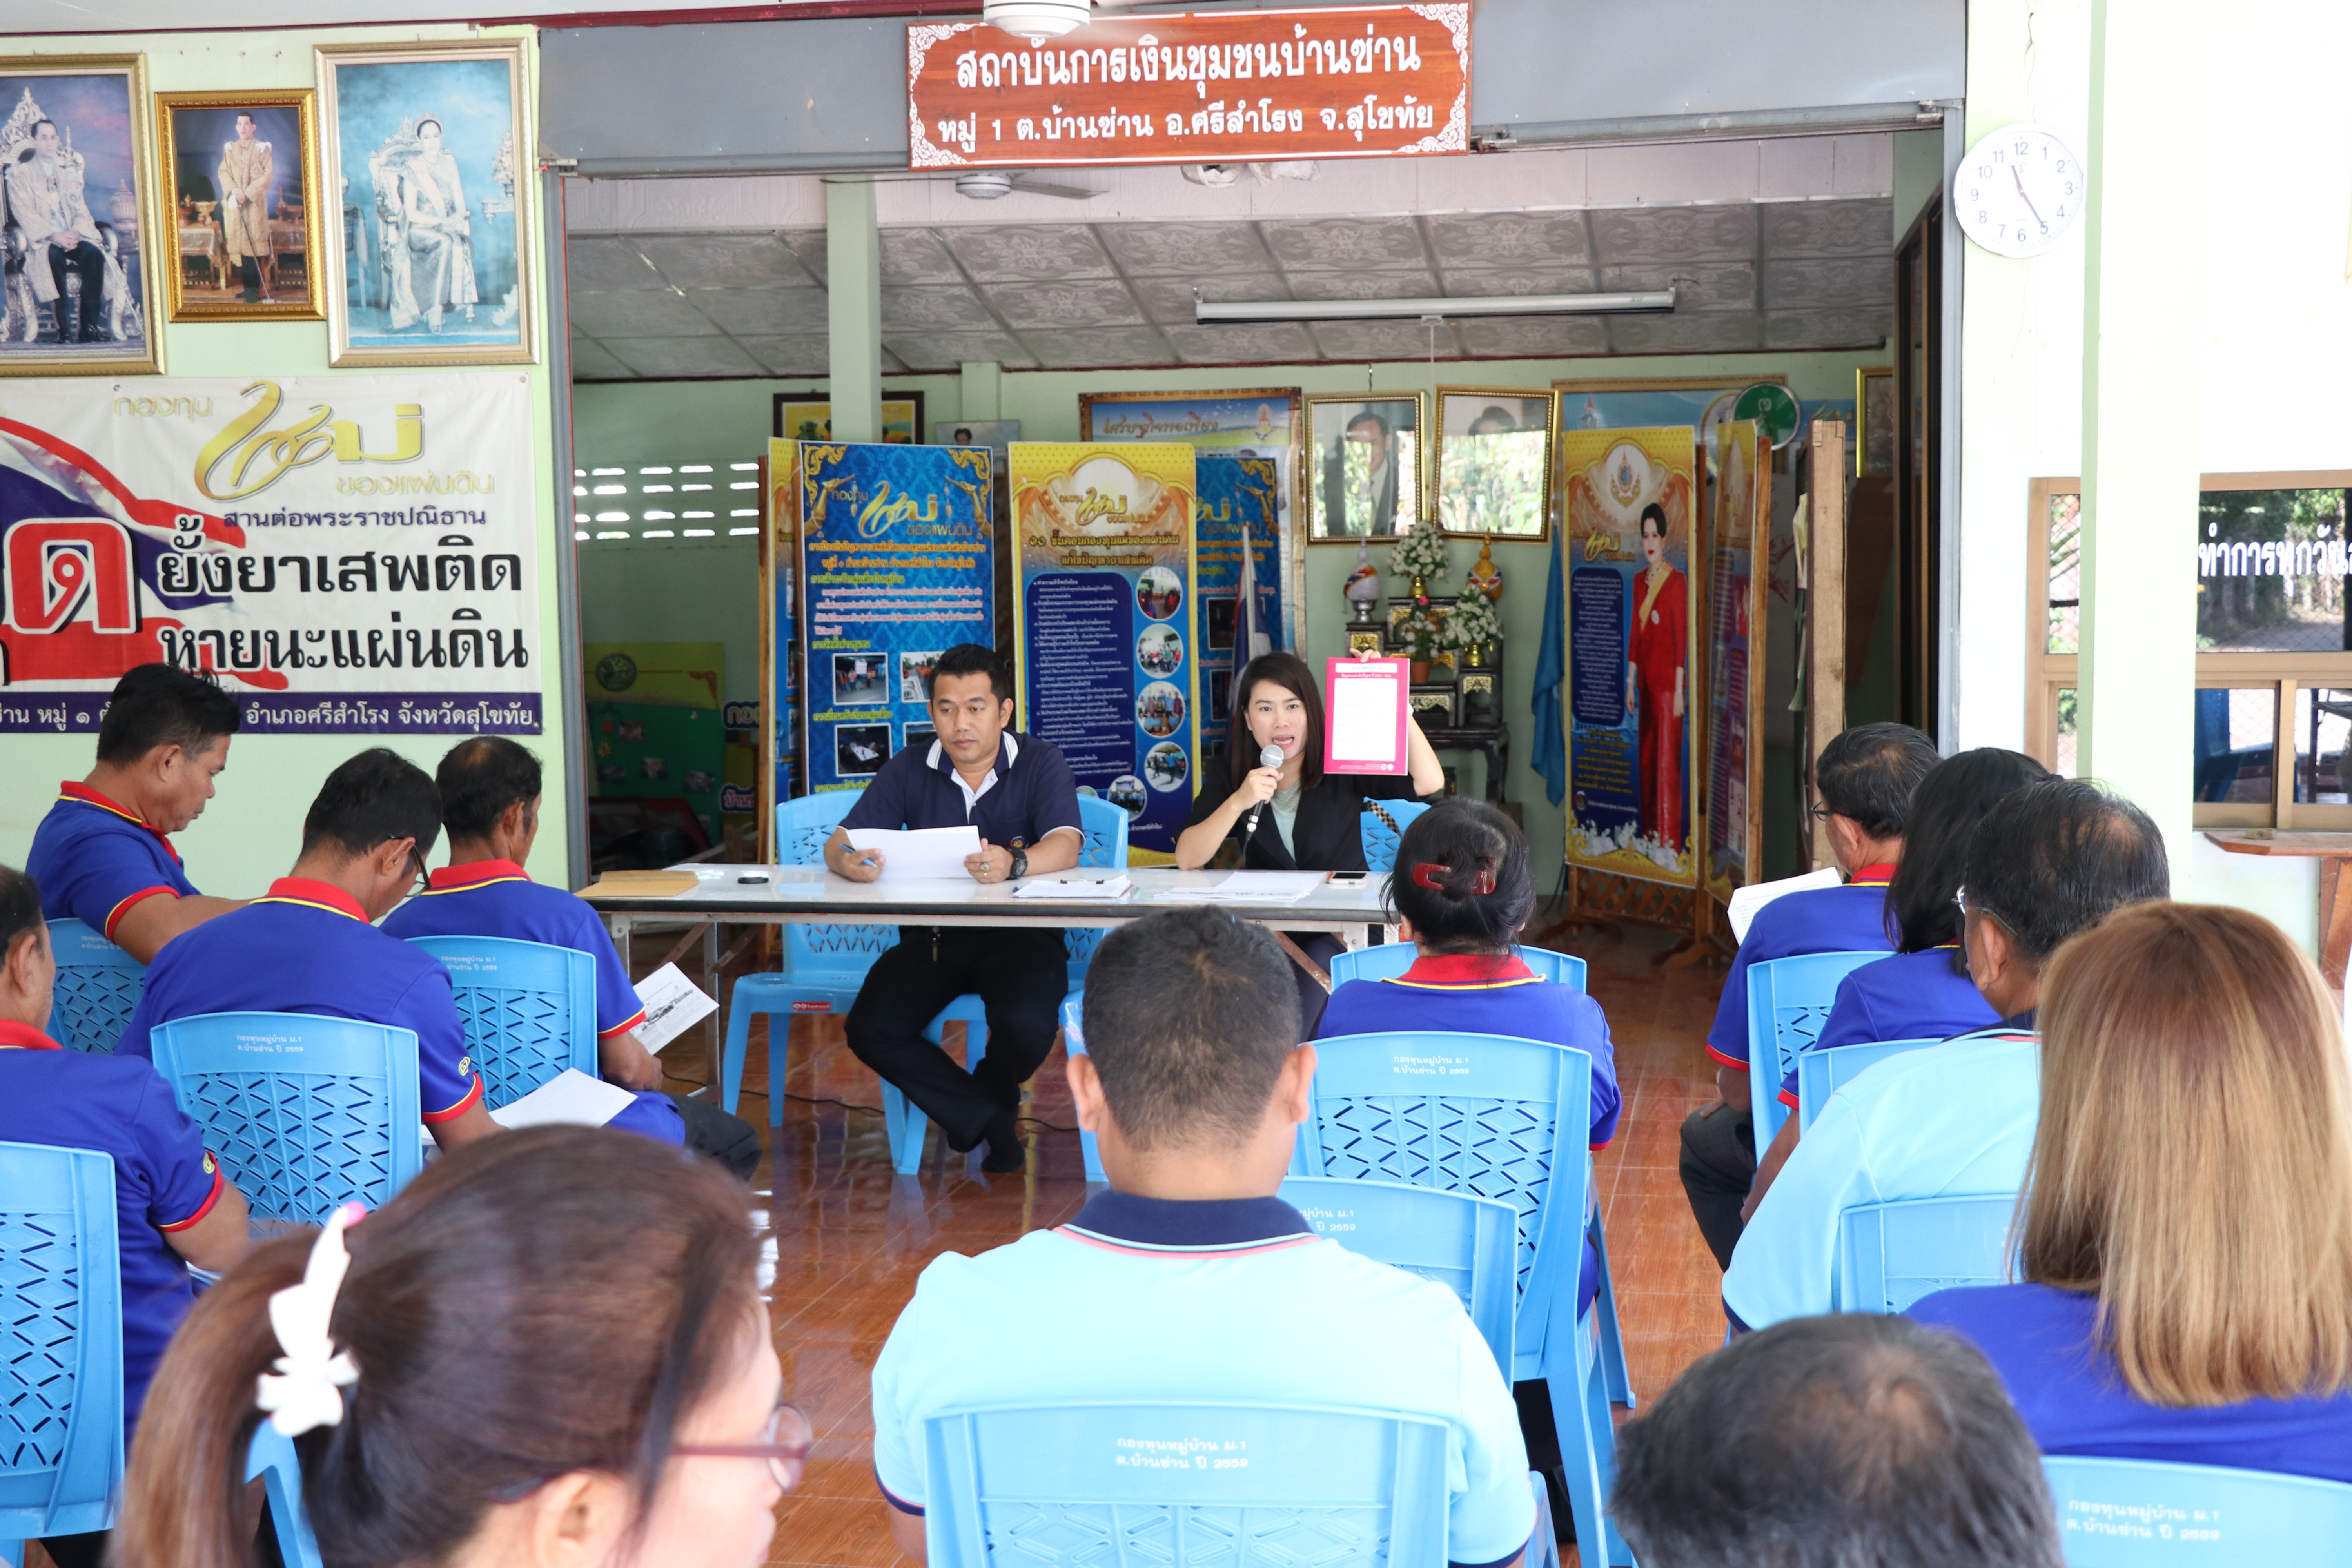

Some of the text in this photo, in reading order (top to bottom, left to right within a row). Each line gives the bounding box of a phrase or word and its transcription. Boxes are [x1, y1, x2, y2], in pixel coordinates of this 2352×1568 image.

[956, 23, 1421, 99] สถาบันการเงินชุมชนบ้านซ่าน
[938, 112, 975, 153] หมู่
[1016, 104, 1154, 140] ต.บ้านซ่าน
[1166, 98, 1303, 136] อ.ศรีสำโรง
[1319, 94, 1433, 142] จ.สุโขทัย
[2014, 142, 2029, 155] 12
[2042, 146, 2047, 159] 1
[1993, 150, 2004, 163] 11
[1977, 165, 1993, 179] 10
[2056, 160, 2065, 173] 2
[1970, 188, 1979, 201] 9
[2064, 181, 2073, 195] 3
[1979, 210, 1987, 224] 8
[2056, 205, 2065, 218] 4
[1998, 224, 2005, 237] 7
[2040, 221, 2048, 234] 5
[2017, 229, 2026, 242] 6
[114, 396, 213, 420] กองทุน
[336, 470, 495, 495] ของแผ่นดิน
[223, 505, 487, 528] สานต่อพระราชปณิธาน
[160, 516, 522, 593] ยั้งยาเสพติด
[2198, 522, 2352, 597] ทำการทุกวัน
[160, 607, 529, 669] หายนะแผ่นดิน
[37, 702, 67, 731] หมู่
[76, 711, 90, 724] ๑
[246, 702, 390, 724] อำเภอศรีสำโรง
[397, 702, 532, 731] จังหวัดสุโขทัย
[1439, 1066, 1446, 1074] ปี
[1316, 1221, 1325, 1231] ปี
[1224, 1441, 1247, 1450] ม.1
[1195, 1455, 1207, 1468] ปี
[1214, 1458, 1249, 1468] 2559
